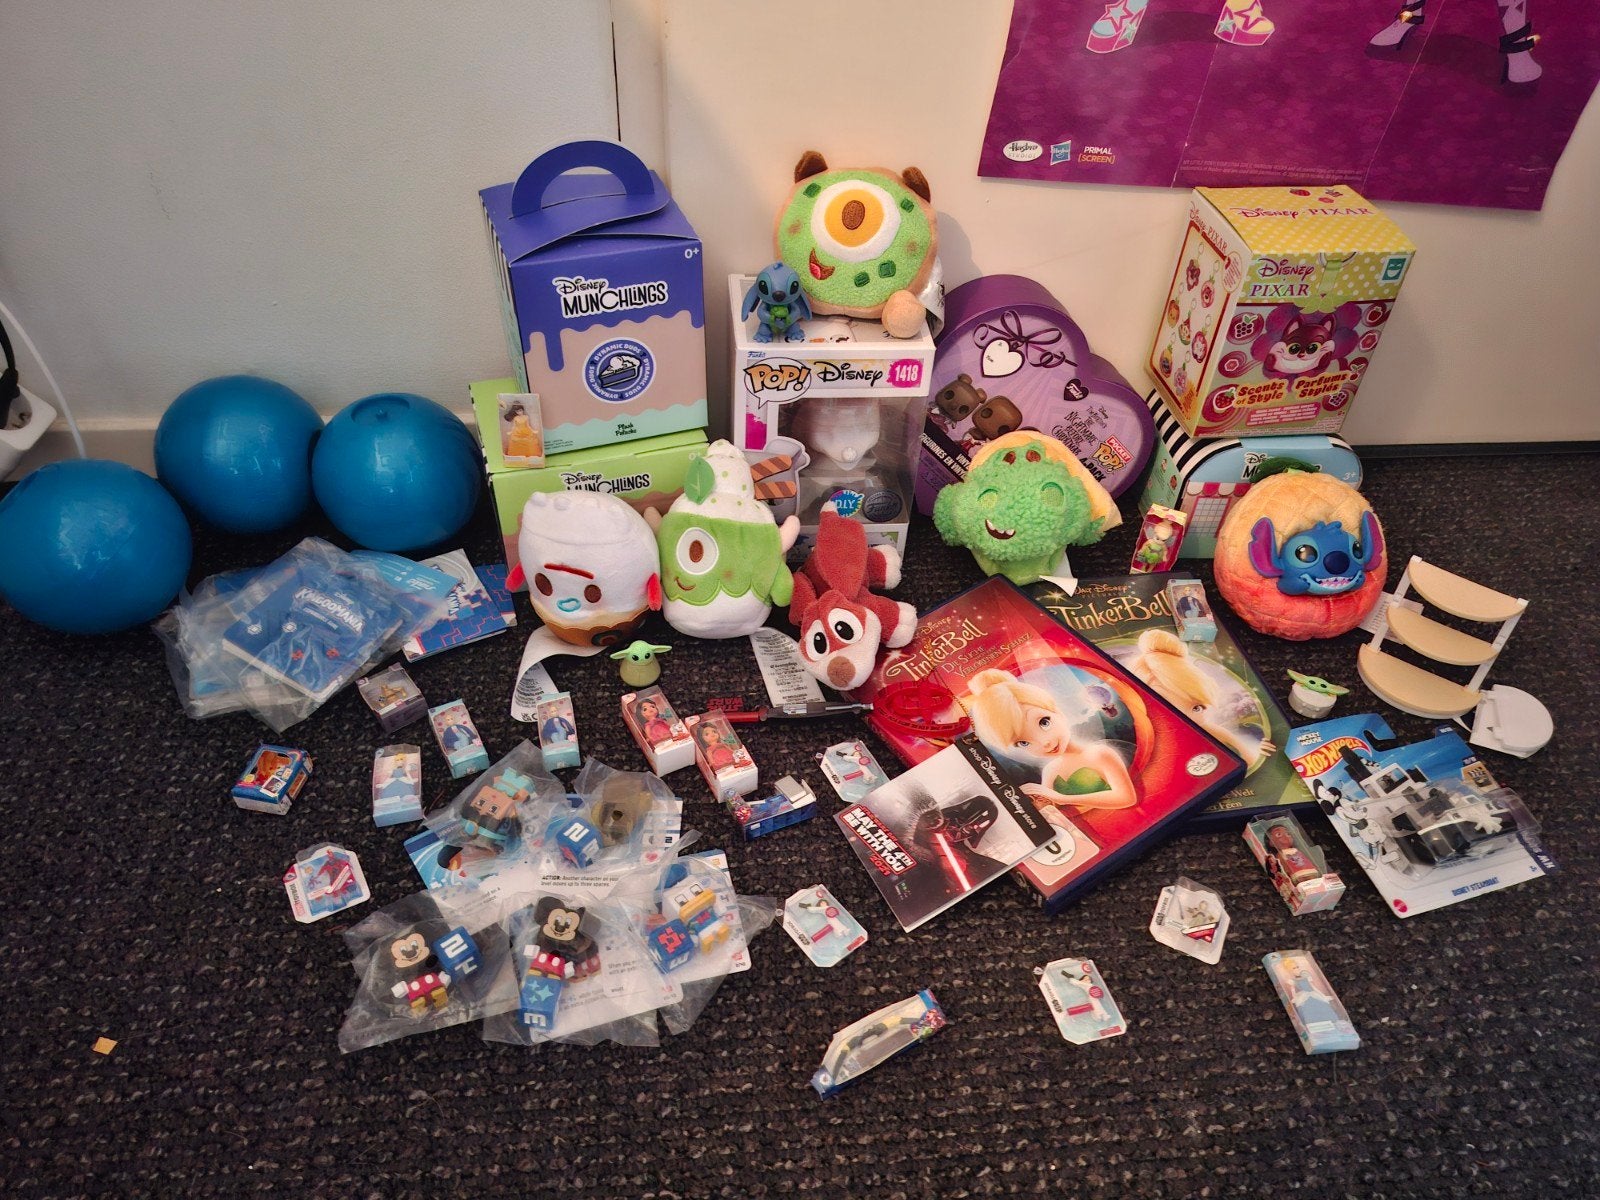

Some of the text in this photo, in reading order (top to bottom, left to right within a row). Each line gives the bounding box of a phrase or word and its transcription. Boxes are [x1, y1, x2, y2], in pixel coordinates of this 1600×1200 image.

[1084, 146, 1113, 155] PRIMAL
[1230, 206, 1376, 219] Disney PIXAR
[1207, 226, 1228, 253] PIXAR
[1257, 257, 1315, 281] Disney
[554, 278, 606, 294] Disney
[1249, 283, 1310, 297] PIXAR
[562, 283, 666, 316] MUNCHLINGS
[743, 363, 812, 394] POP!
[813, 361, 883, 387] Disney
[894, 364, 919, 382] 1418
[1295, 372, 1348, 390] Parfums
[1237, 380, 1285, 396] Scents
[1246, 391, 1284, 406] Style
[1091, 442, 1125, 474] POP!
[1108, 436, 1132, 462] POCKET
[943, 456, 955, 467] EN
[560, 472, 602, 485] Disney
[968, 746, 1003, 786] shop Disney
[1303, 749, 1330, 776] HOT
[1231, 788, 1255, 800] Welt
[1003, 784, 1037, 830] Disney store
[1219, 800, 1243, 811] Feen
[842, 812, 906, 873] BE WITH YOU
[851, 807, 879, 829] MAY
[874, 828, 899, 852] THE
[893, 851, 914, 867] 4TH
[869, 854, 892, 876] 2021
[1452, 876, 1500, 896] DISNEY STEAMBOAT
[440, 933, 468, 959] 2
